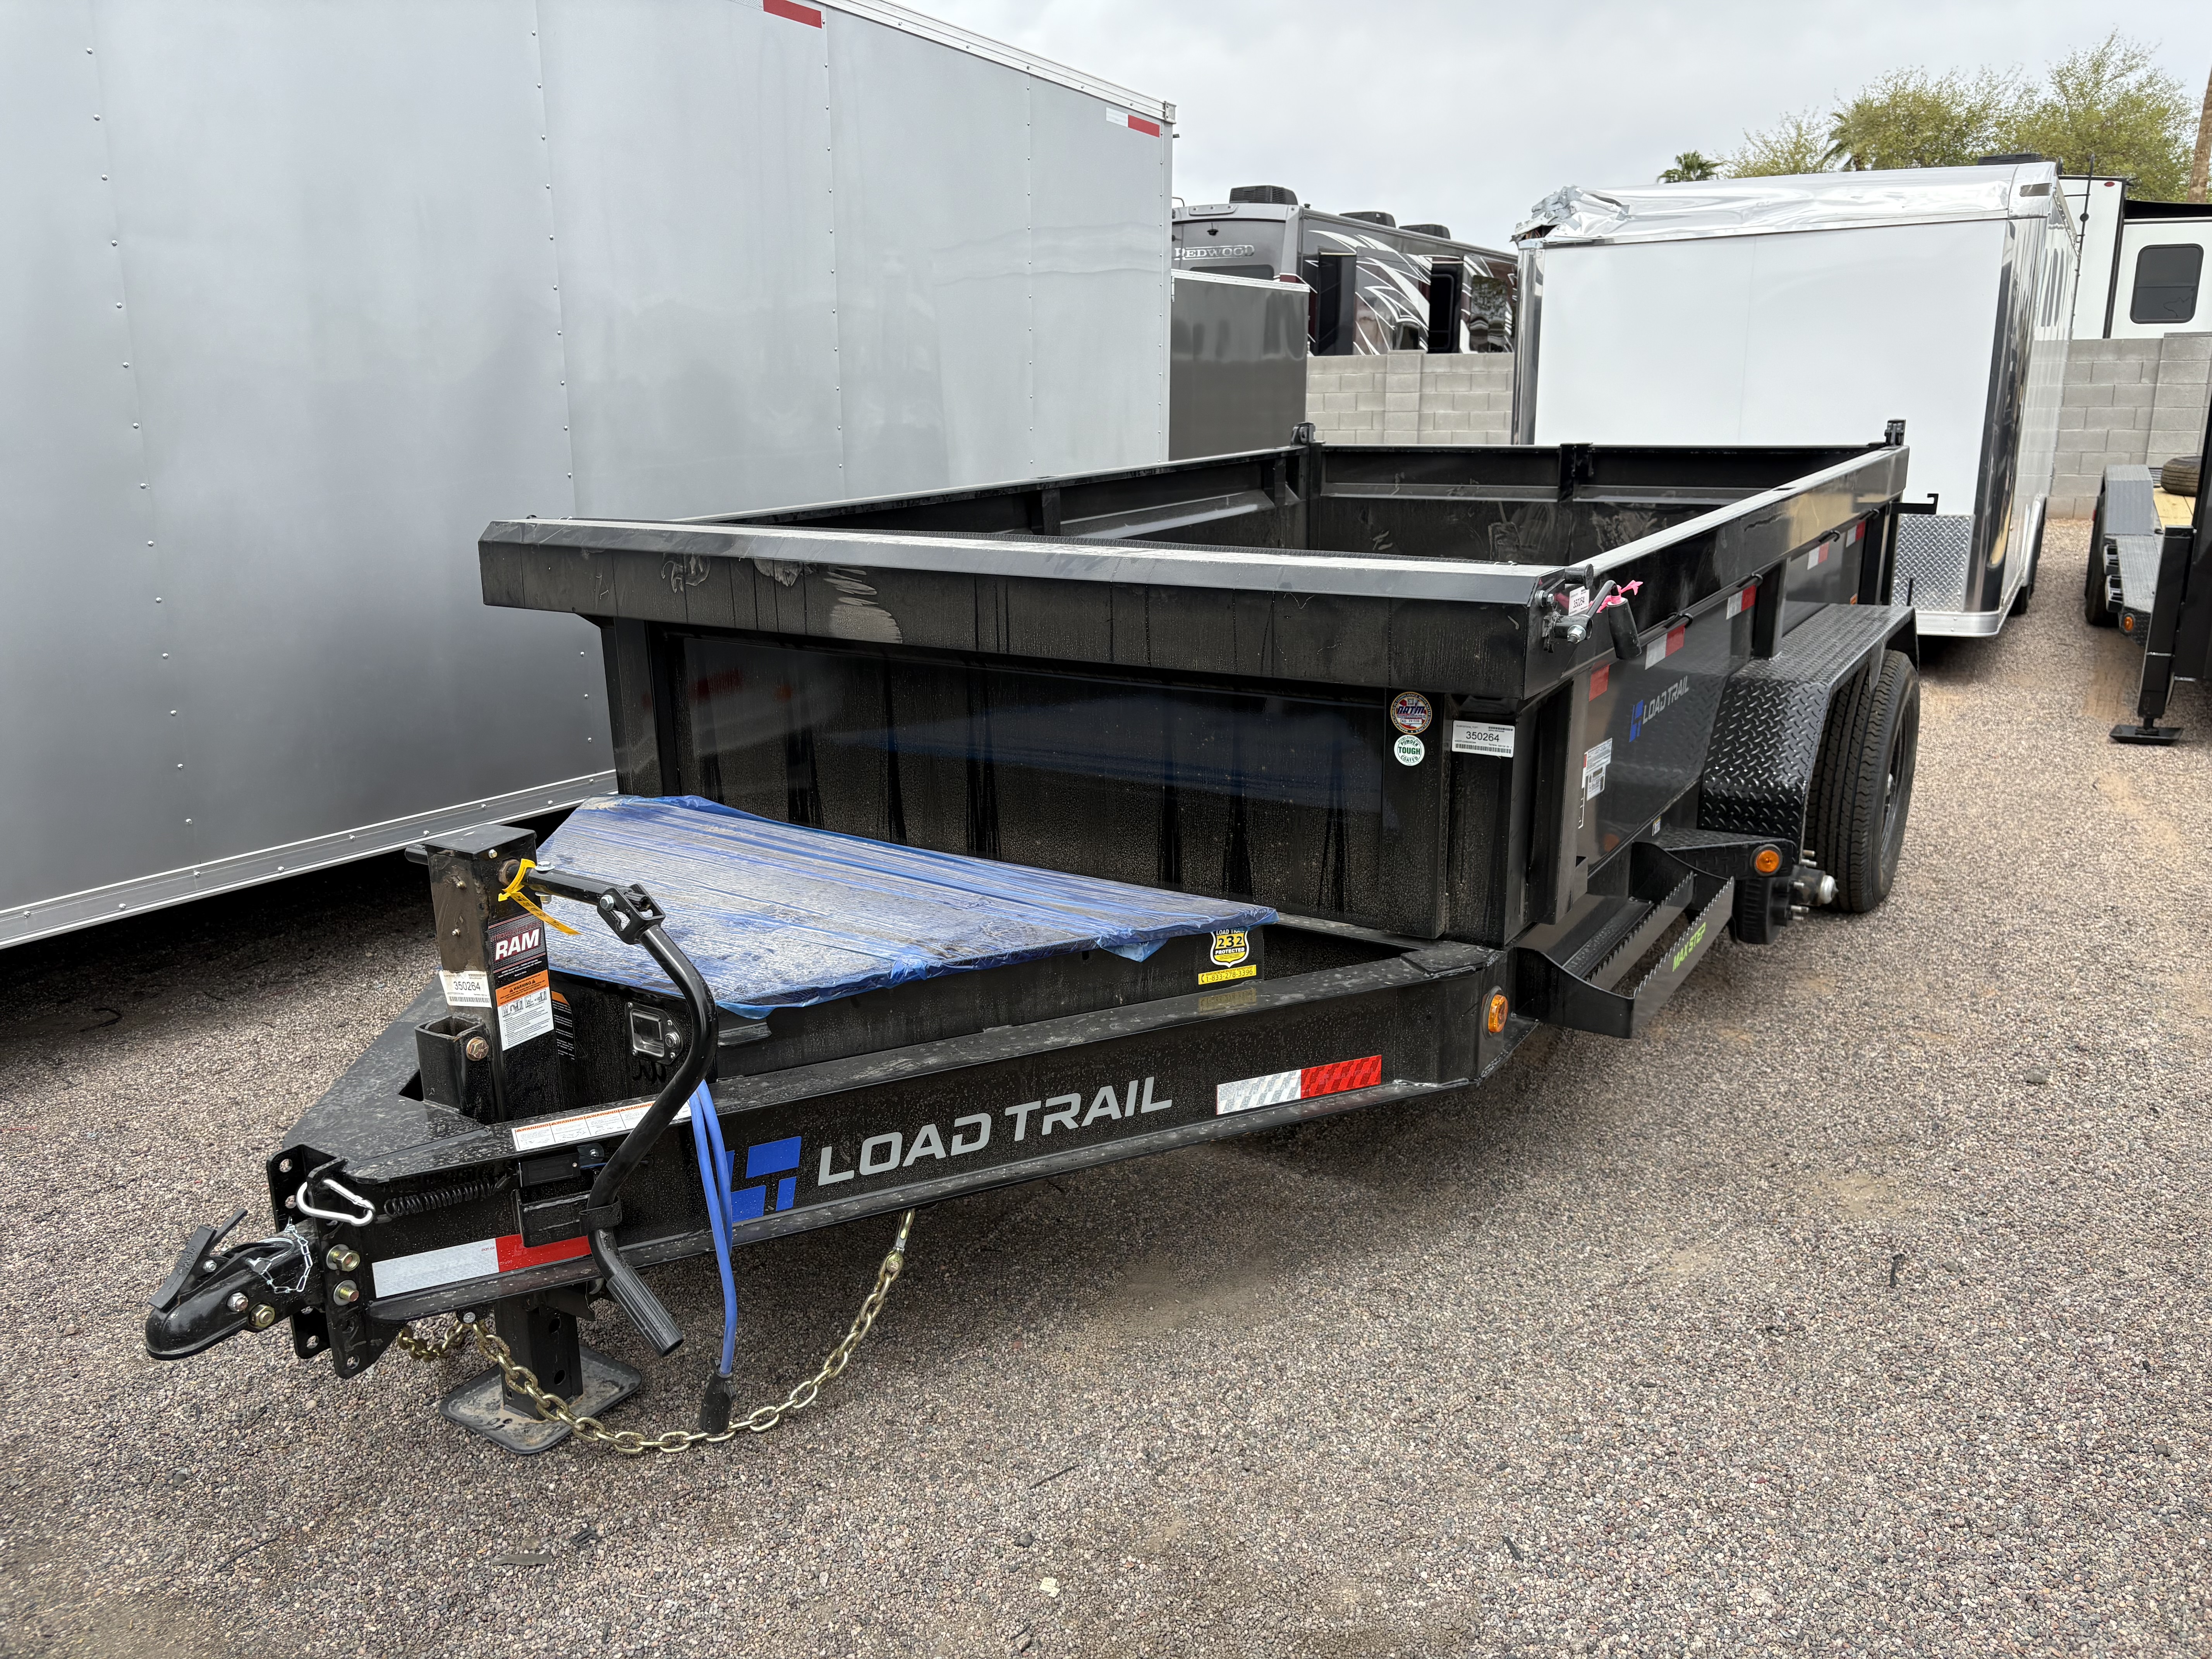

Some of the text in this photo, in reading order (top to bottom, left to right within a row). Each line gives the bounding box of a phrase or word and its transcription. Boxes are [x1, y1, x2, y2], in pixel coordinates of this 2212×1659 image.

[1174, 245, 1255, 261] REDWOOD
[1643, 675, 1689, 725] LOAD TRAIL
[1466, 731, 1499, 742] 350264
[1398, 746, 1420, 755] TOUGH
[495, 928, 541, 961] RAM
[1218, 936, 1242, 947] 232
[1206, 969, 1253, 982] 1-833-278-3396
[453, 981, 481, 991] 350264
[818, 1113, 991, 1186] LOAD
[1005, 1076, 1173, 1141] TRAIL
